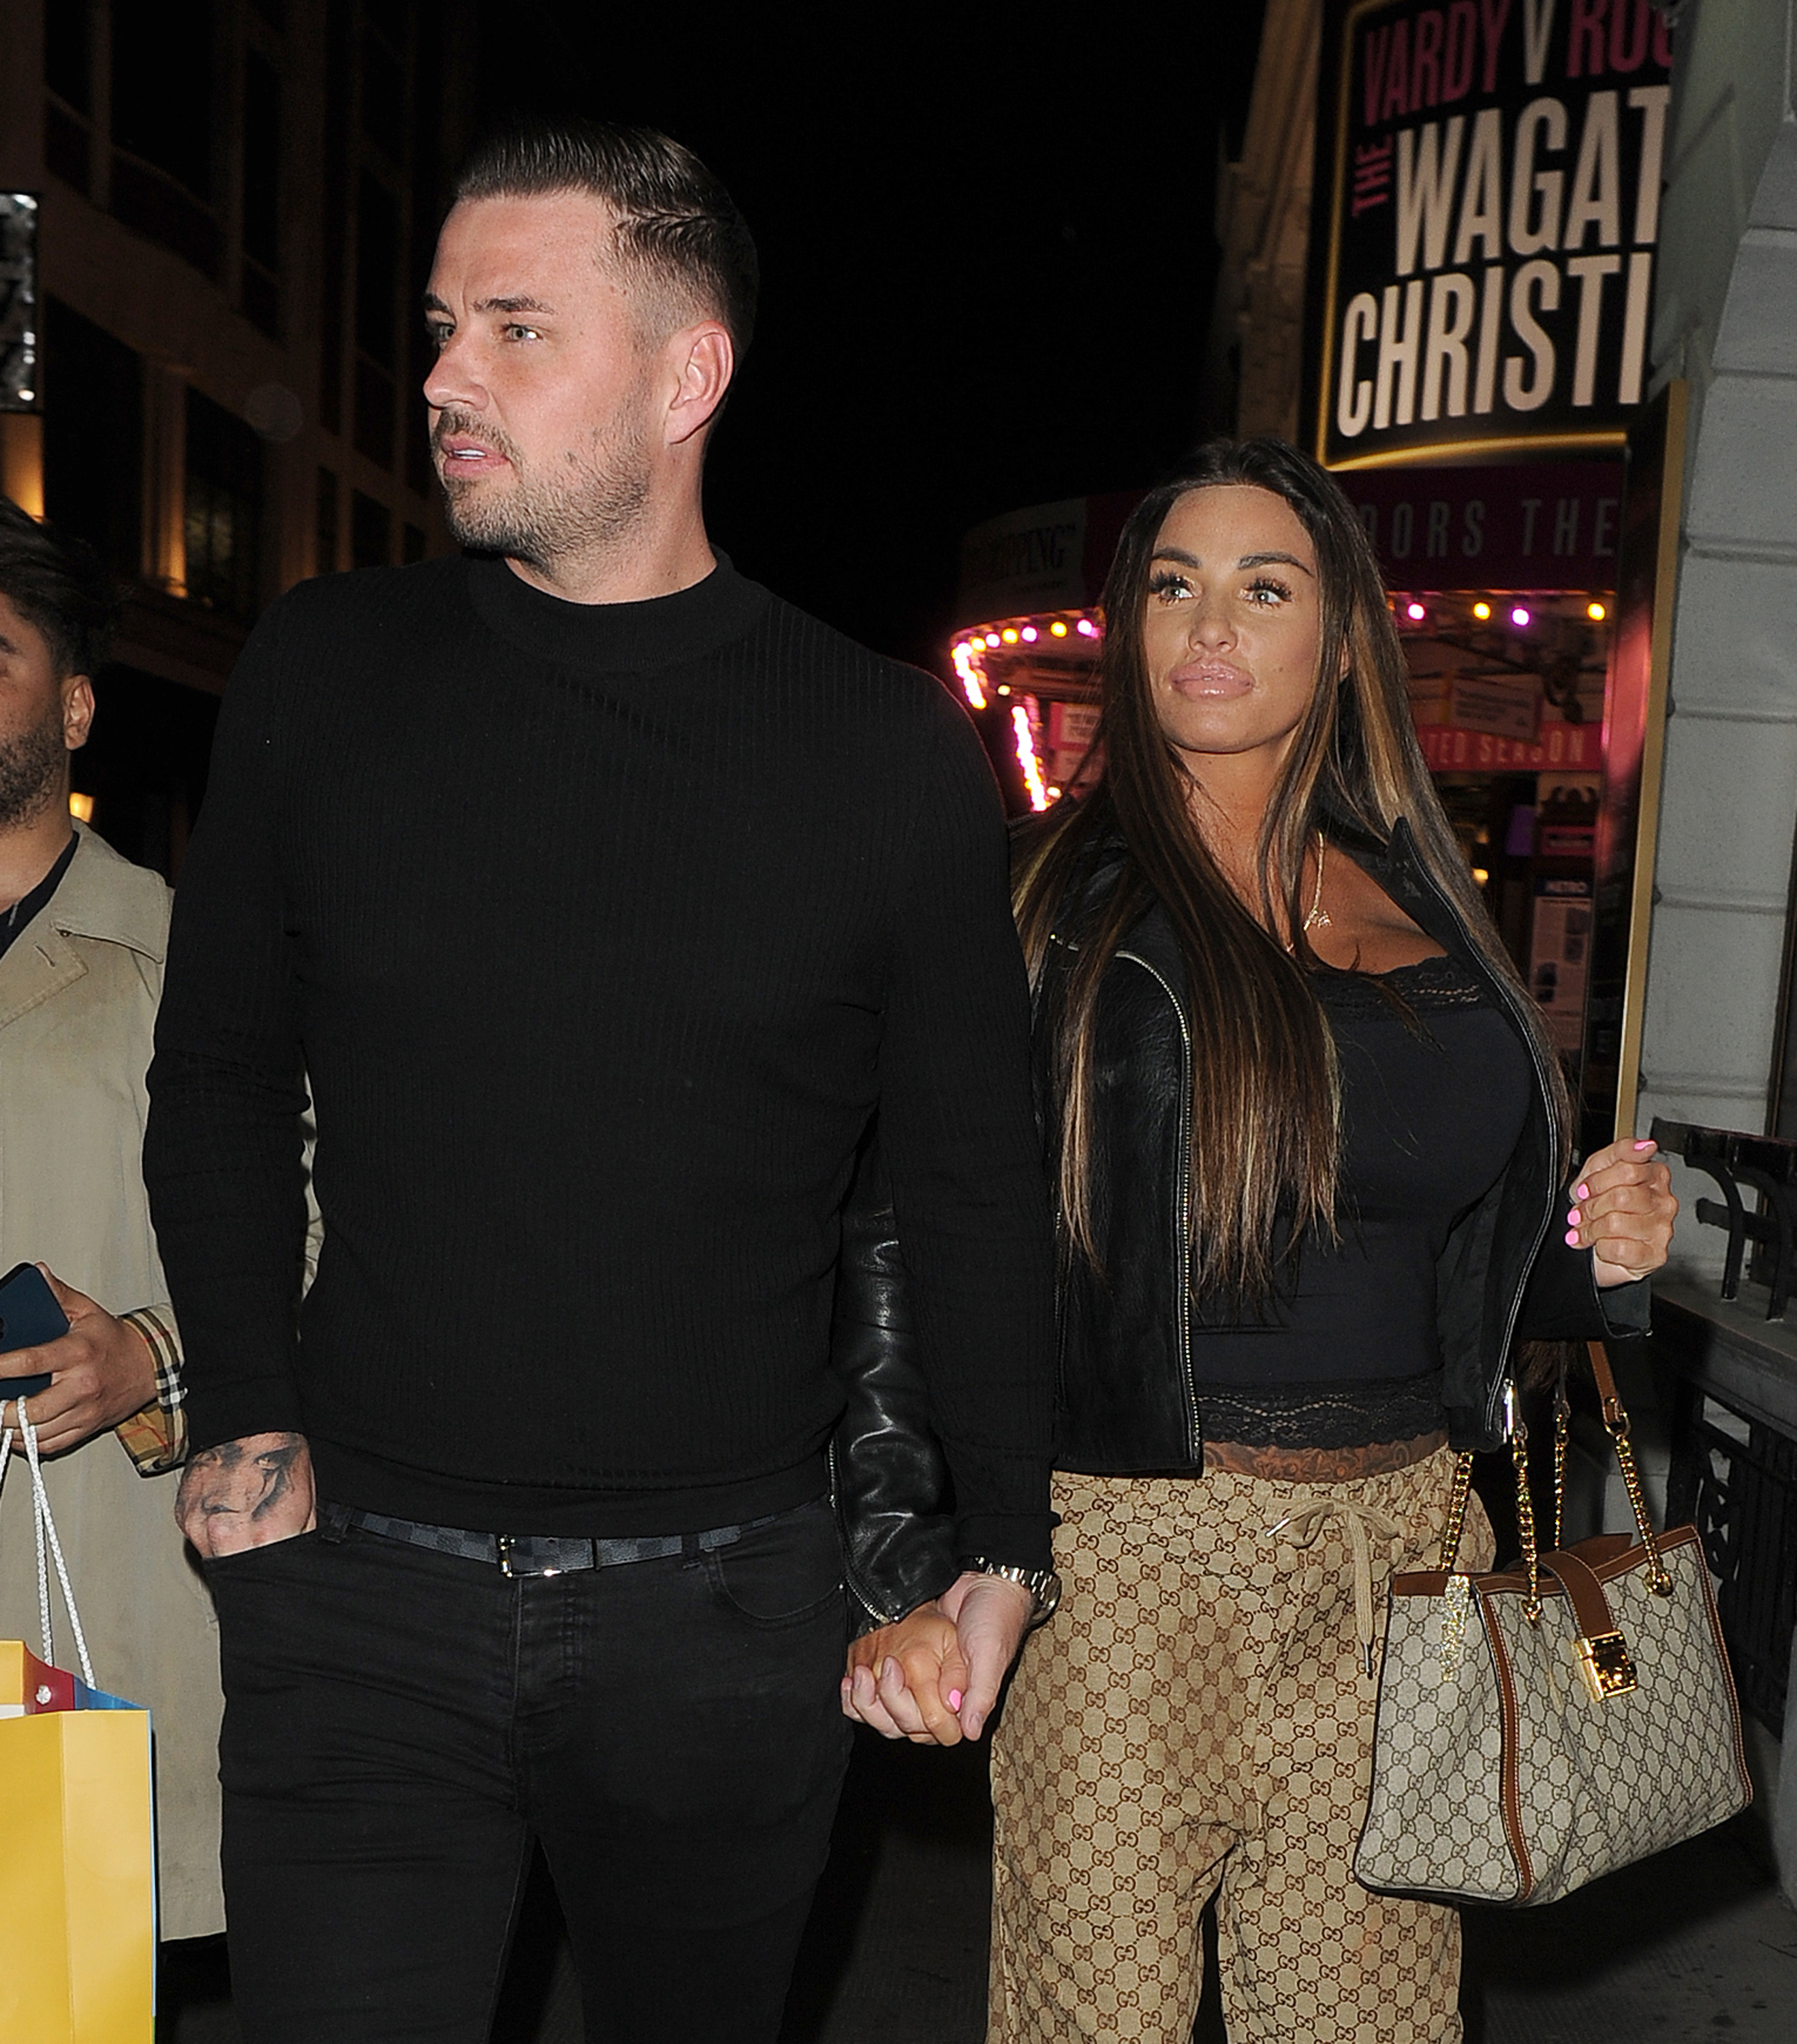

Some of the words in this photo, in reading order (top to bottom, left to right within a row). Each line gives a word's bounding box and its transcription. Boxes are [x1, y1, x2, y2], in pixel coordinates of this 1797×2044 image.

[1363, 0, 1512, 127] VARDY
[1522, 0, 1556, 86] V
[1351, 134, 1393, 219] THE
[1395, 84, 1671, 277] WAGAT
[1337, 251, 1653, 437] CHRISTI
[1520, 497, 1621, 557] THE
